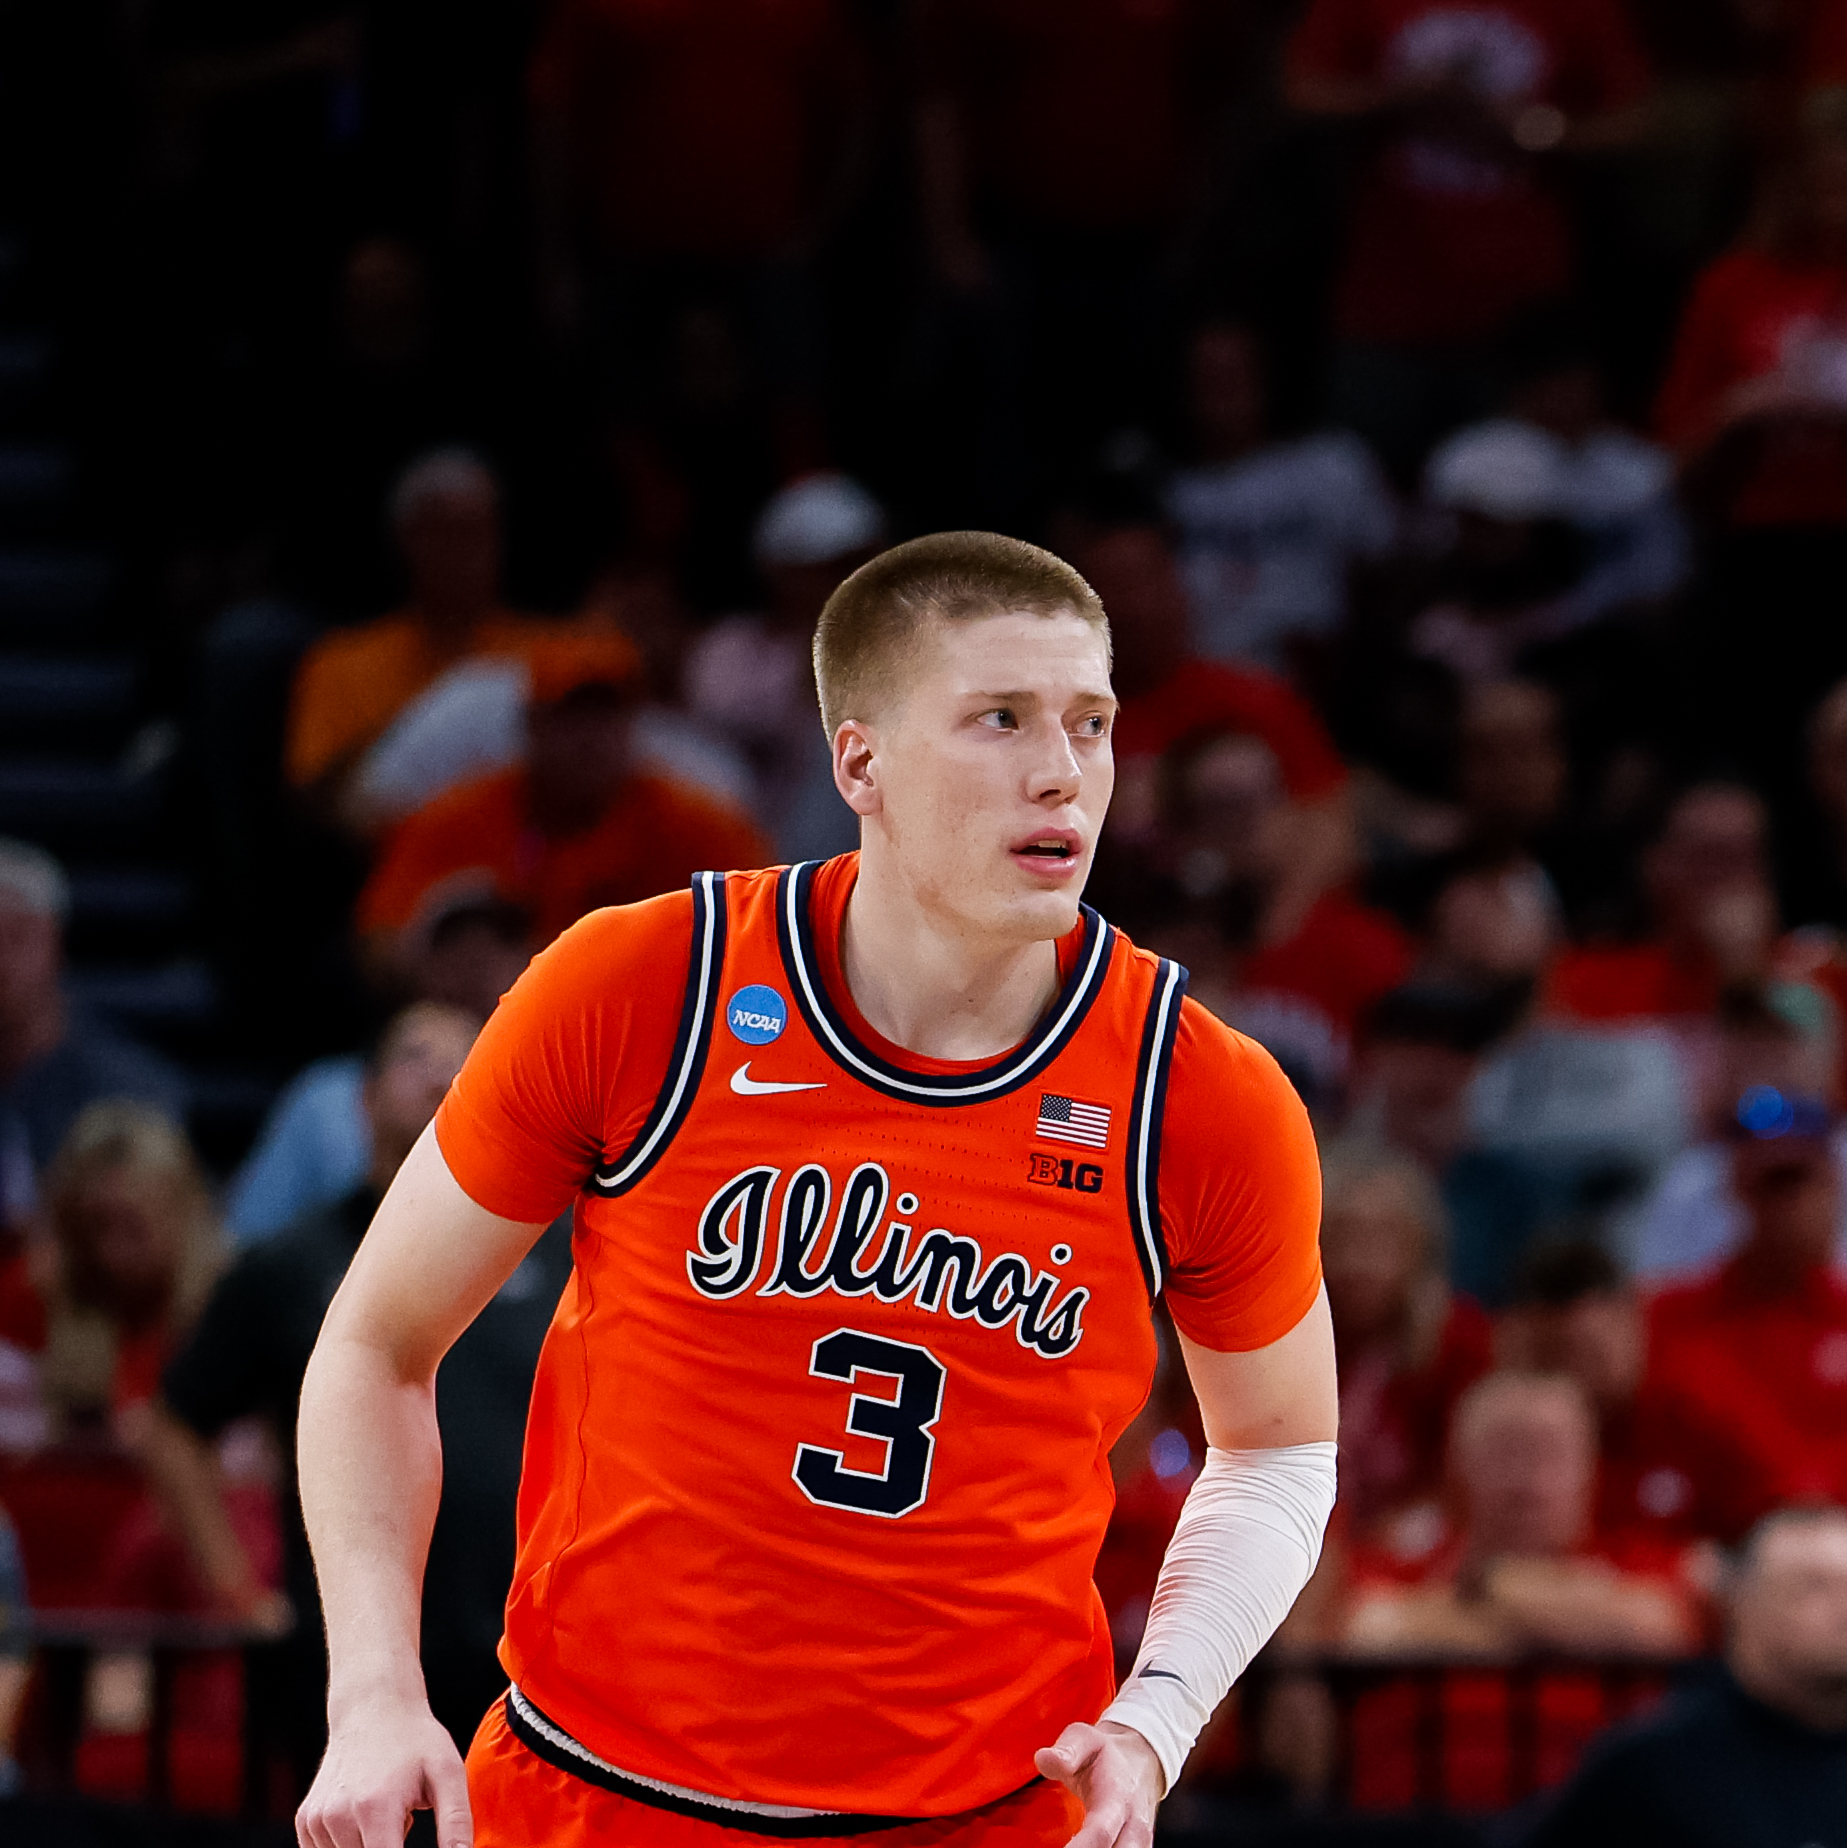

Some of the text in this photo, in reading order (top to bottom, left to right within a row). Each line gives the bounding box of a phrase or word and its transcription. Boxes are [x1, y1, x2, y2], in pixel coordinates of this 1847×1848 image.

[733, 1009, 782, 1034] NCAA
[686, 1162, 1090, 1359] Illinois
[792, 1327, 947, 1519] 3
